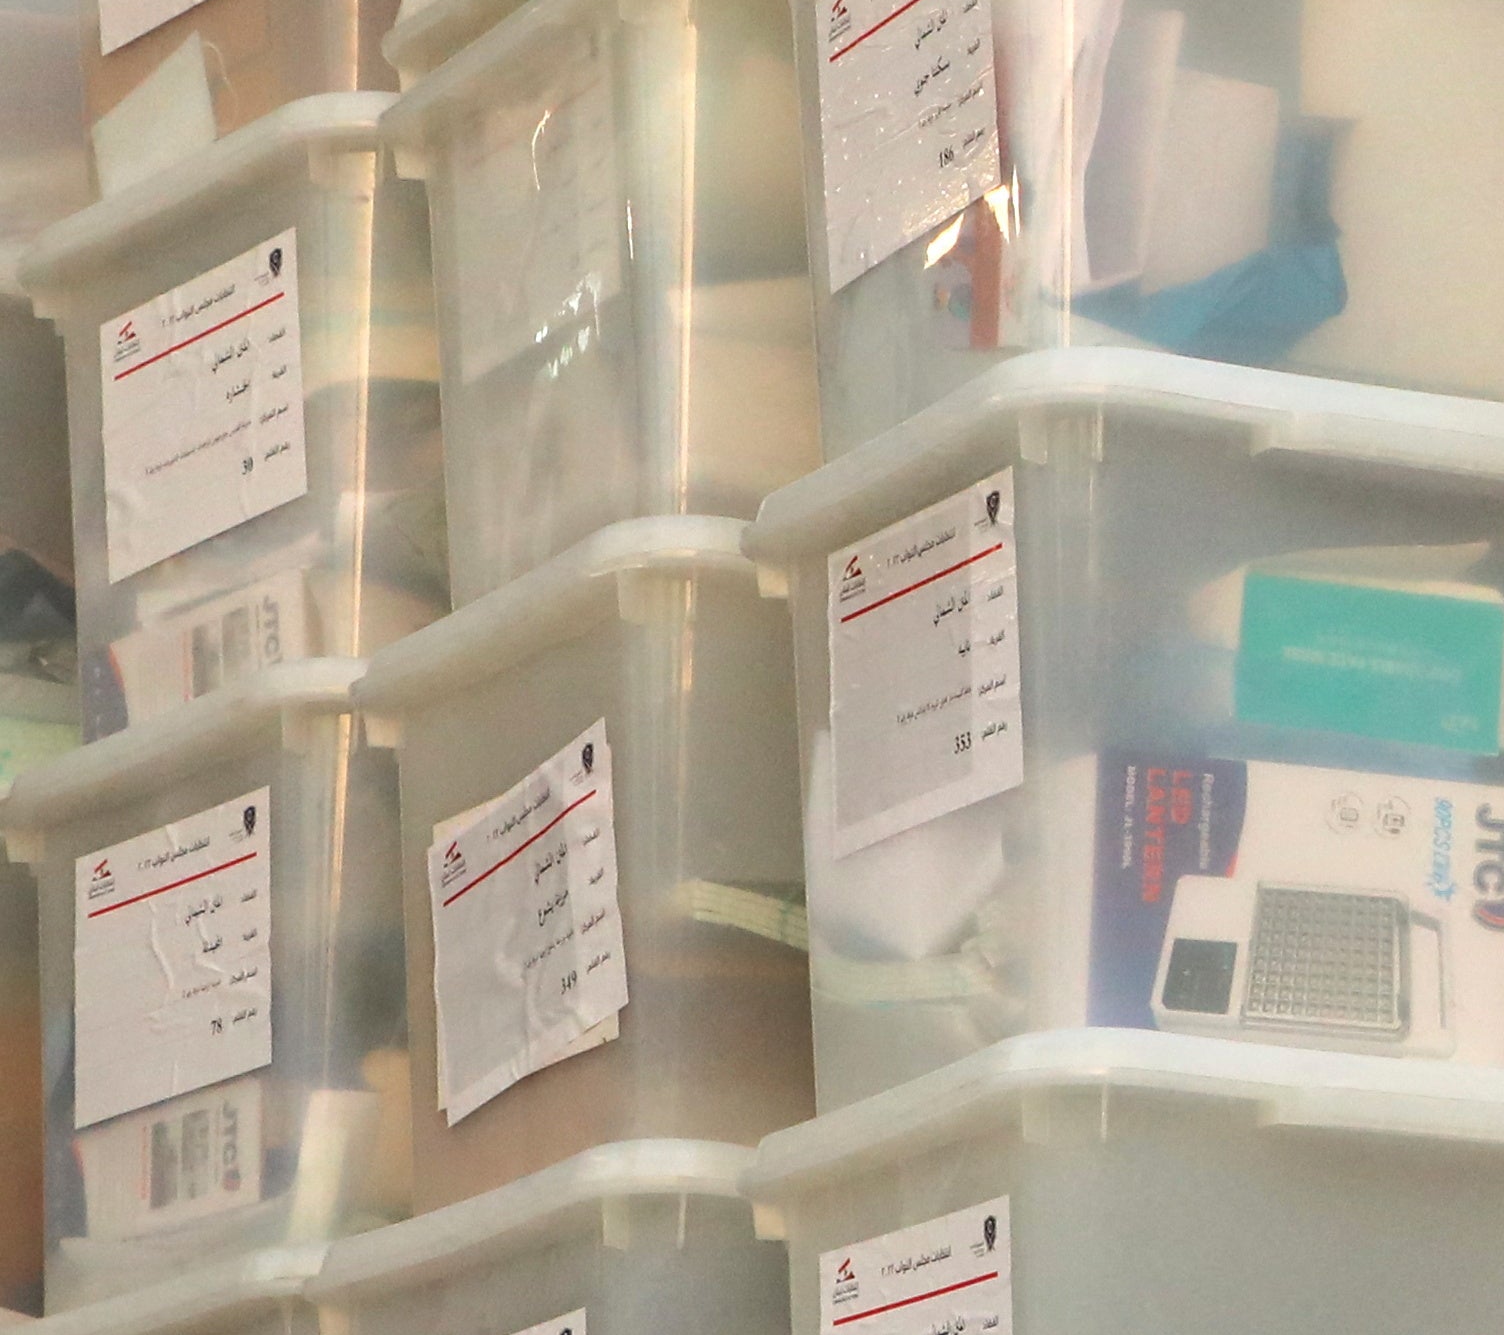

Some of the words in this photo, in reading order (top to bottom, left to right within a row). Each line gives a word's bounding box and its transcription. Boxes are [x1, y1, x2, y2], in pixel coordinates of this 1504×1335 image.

[1170, 770, 1193, 826] LED
[1141, 768, 1168, 904] LANTERN
[211, 1017, 223, 1036] 78
